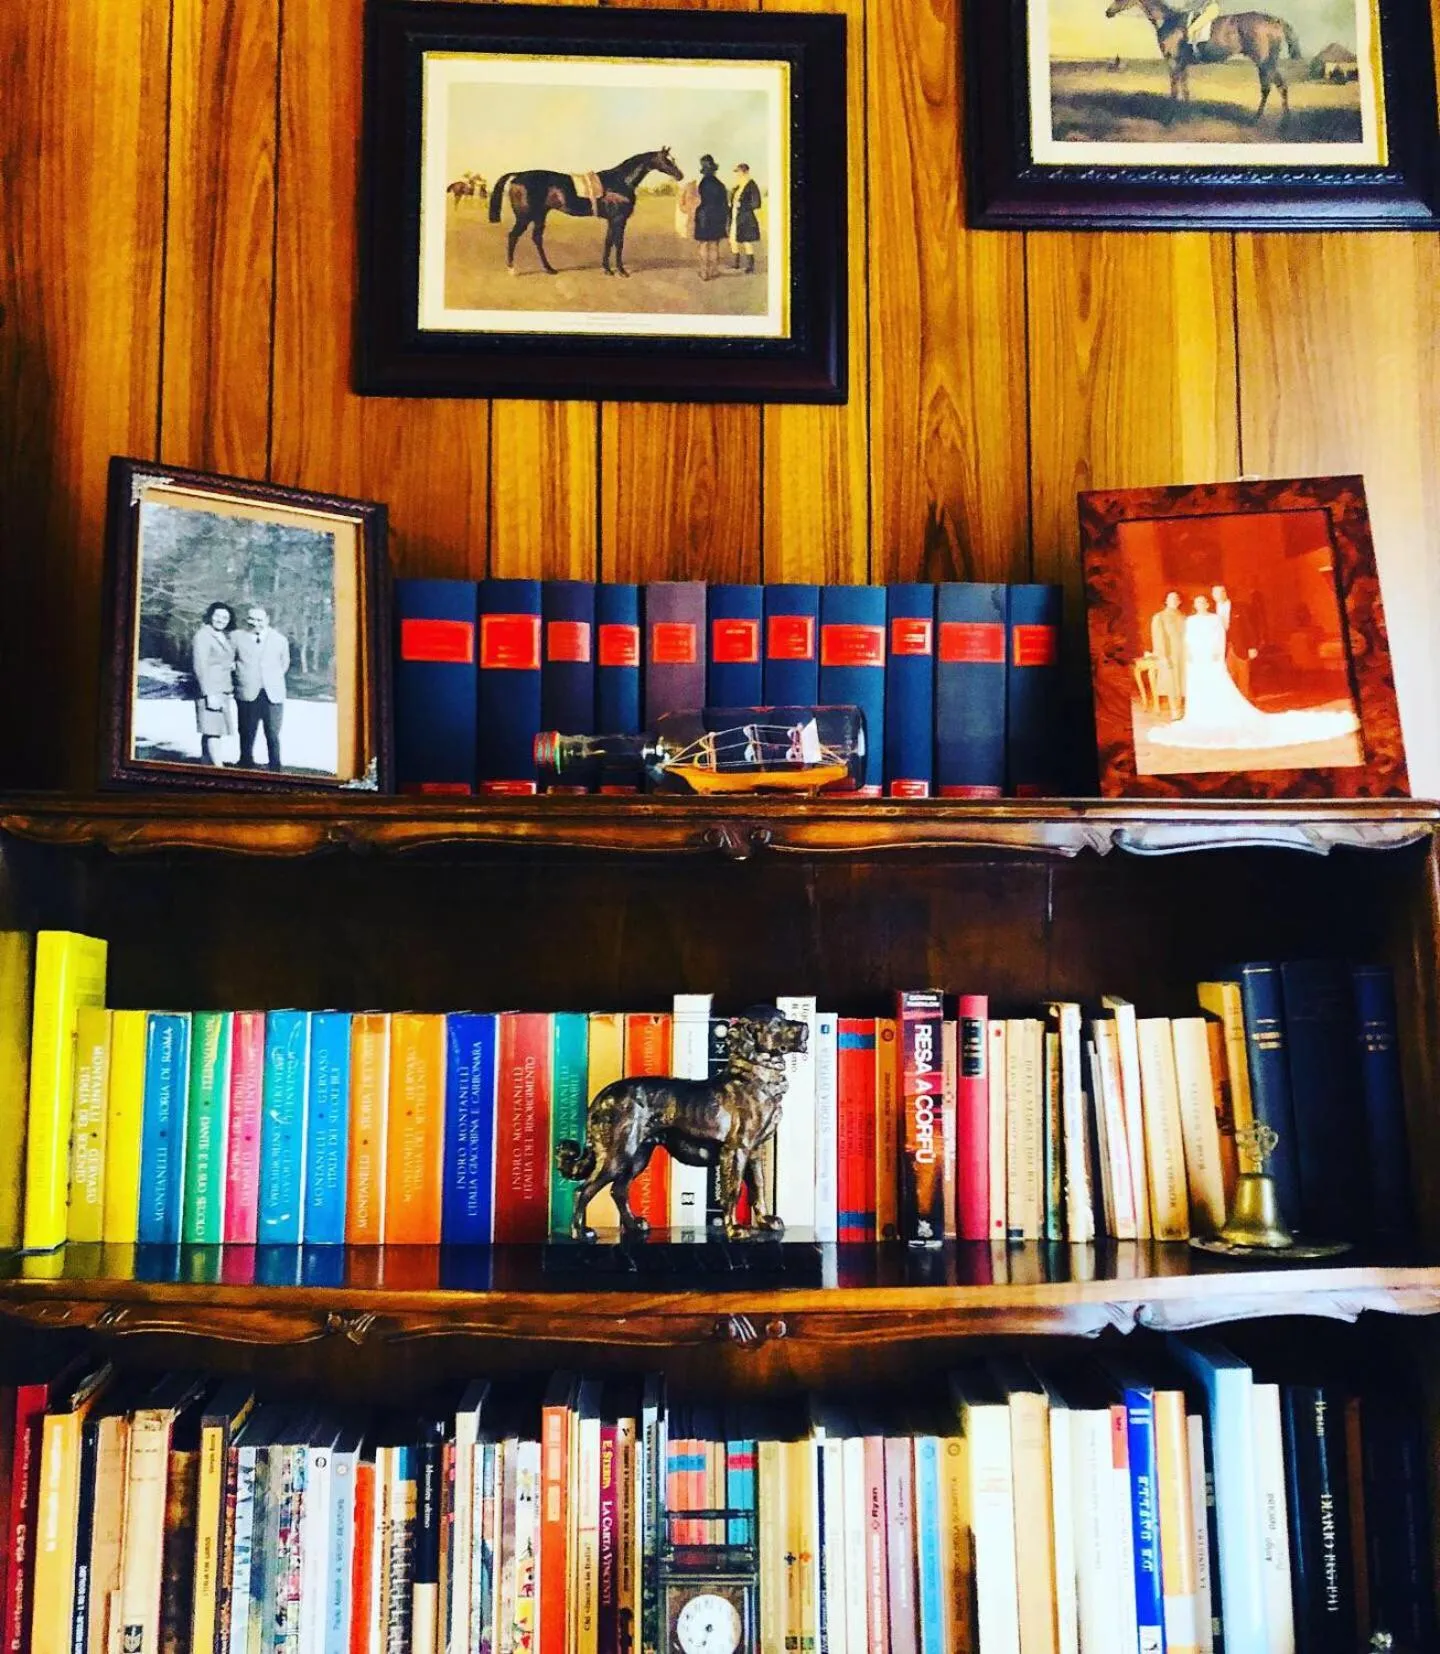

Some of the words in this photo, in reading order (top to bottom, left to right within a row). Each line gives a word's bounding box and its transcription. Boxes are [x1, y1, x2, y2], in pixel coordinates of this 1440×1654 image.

[162, 1027, 173, 1062] ROMA
[201, 1020, 215, 1090] MONTANELLI
[914, 1024, 932, 1074] RESA
[90, 1046, 104, 1122] MONTANELLI
[161, 1068, 171, 1080] DI
[244, 1047, 258, 1124] MONTANELLI
[317, 1049, 328, 1104] GERVASO
[470, 1041, 483, 1104] CARBONARA
[524, 1056, 536, 1132] RISORGIMENTO
[916, 1082, 933, 1094] A
[159, 1085, 170, 1122] STORIA
[361, 1093, 372, 1130] STORIA
[457, 1066, 470, 1141] MONTANELLI
[512, 1067, 524, 1141] MONTANELLI
[559, 1065, 570, 1139] MONTANELLI
[819, 1095, 831, 1134] STORIA
[199, 1116, 211, 1150] DANTE
[469, 1119, 480, 1174] GIACOBINA
[524, 1138, 534, 1156] DEL
[915, 1095, 936, 1164] CORFÙ
[86, 1148, 100, 1203] GERVASO
[155, 1147, 167, 1221] MONTANELLI
[197, 1173, 208, 1193] SUO
[240, 1151, 252, 1206] GERVASO
[314, 1131, 325, 1207] MONTANELLI
[402, 1127, 414, 1203] MONTANELLI
[455, 1148, 467, 1190] INDRO
[511, 1148, 522, 1191] INDRO
[523, 1161, 534, 1200] L'ITALIA
[196, 1197, 207, 1235] SECOLO
[358, 1154, 370, 1229] MONTANELLI
[467, 1179, 478, 1216] L'ITALIA
[601, 1500, 613, 1516] LA
[871, 1487, 880, 1518] Ryan
[15, 1524, 26, 1562] 1943
[602, 1516, 613, 1552] CARTA
[14, 1568, 24, 1637] settembre
[602, 1553, 613, 1606] VINCENTE
